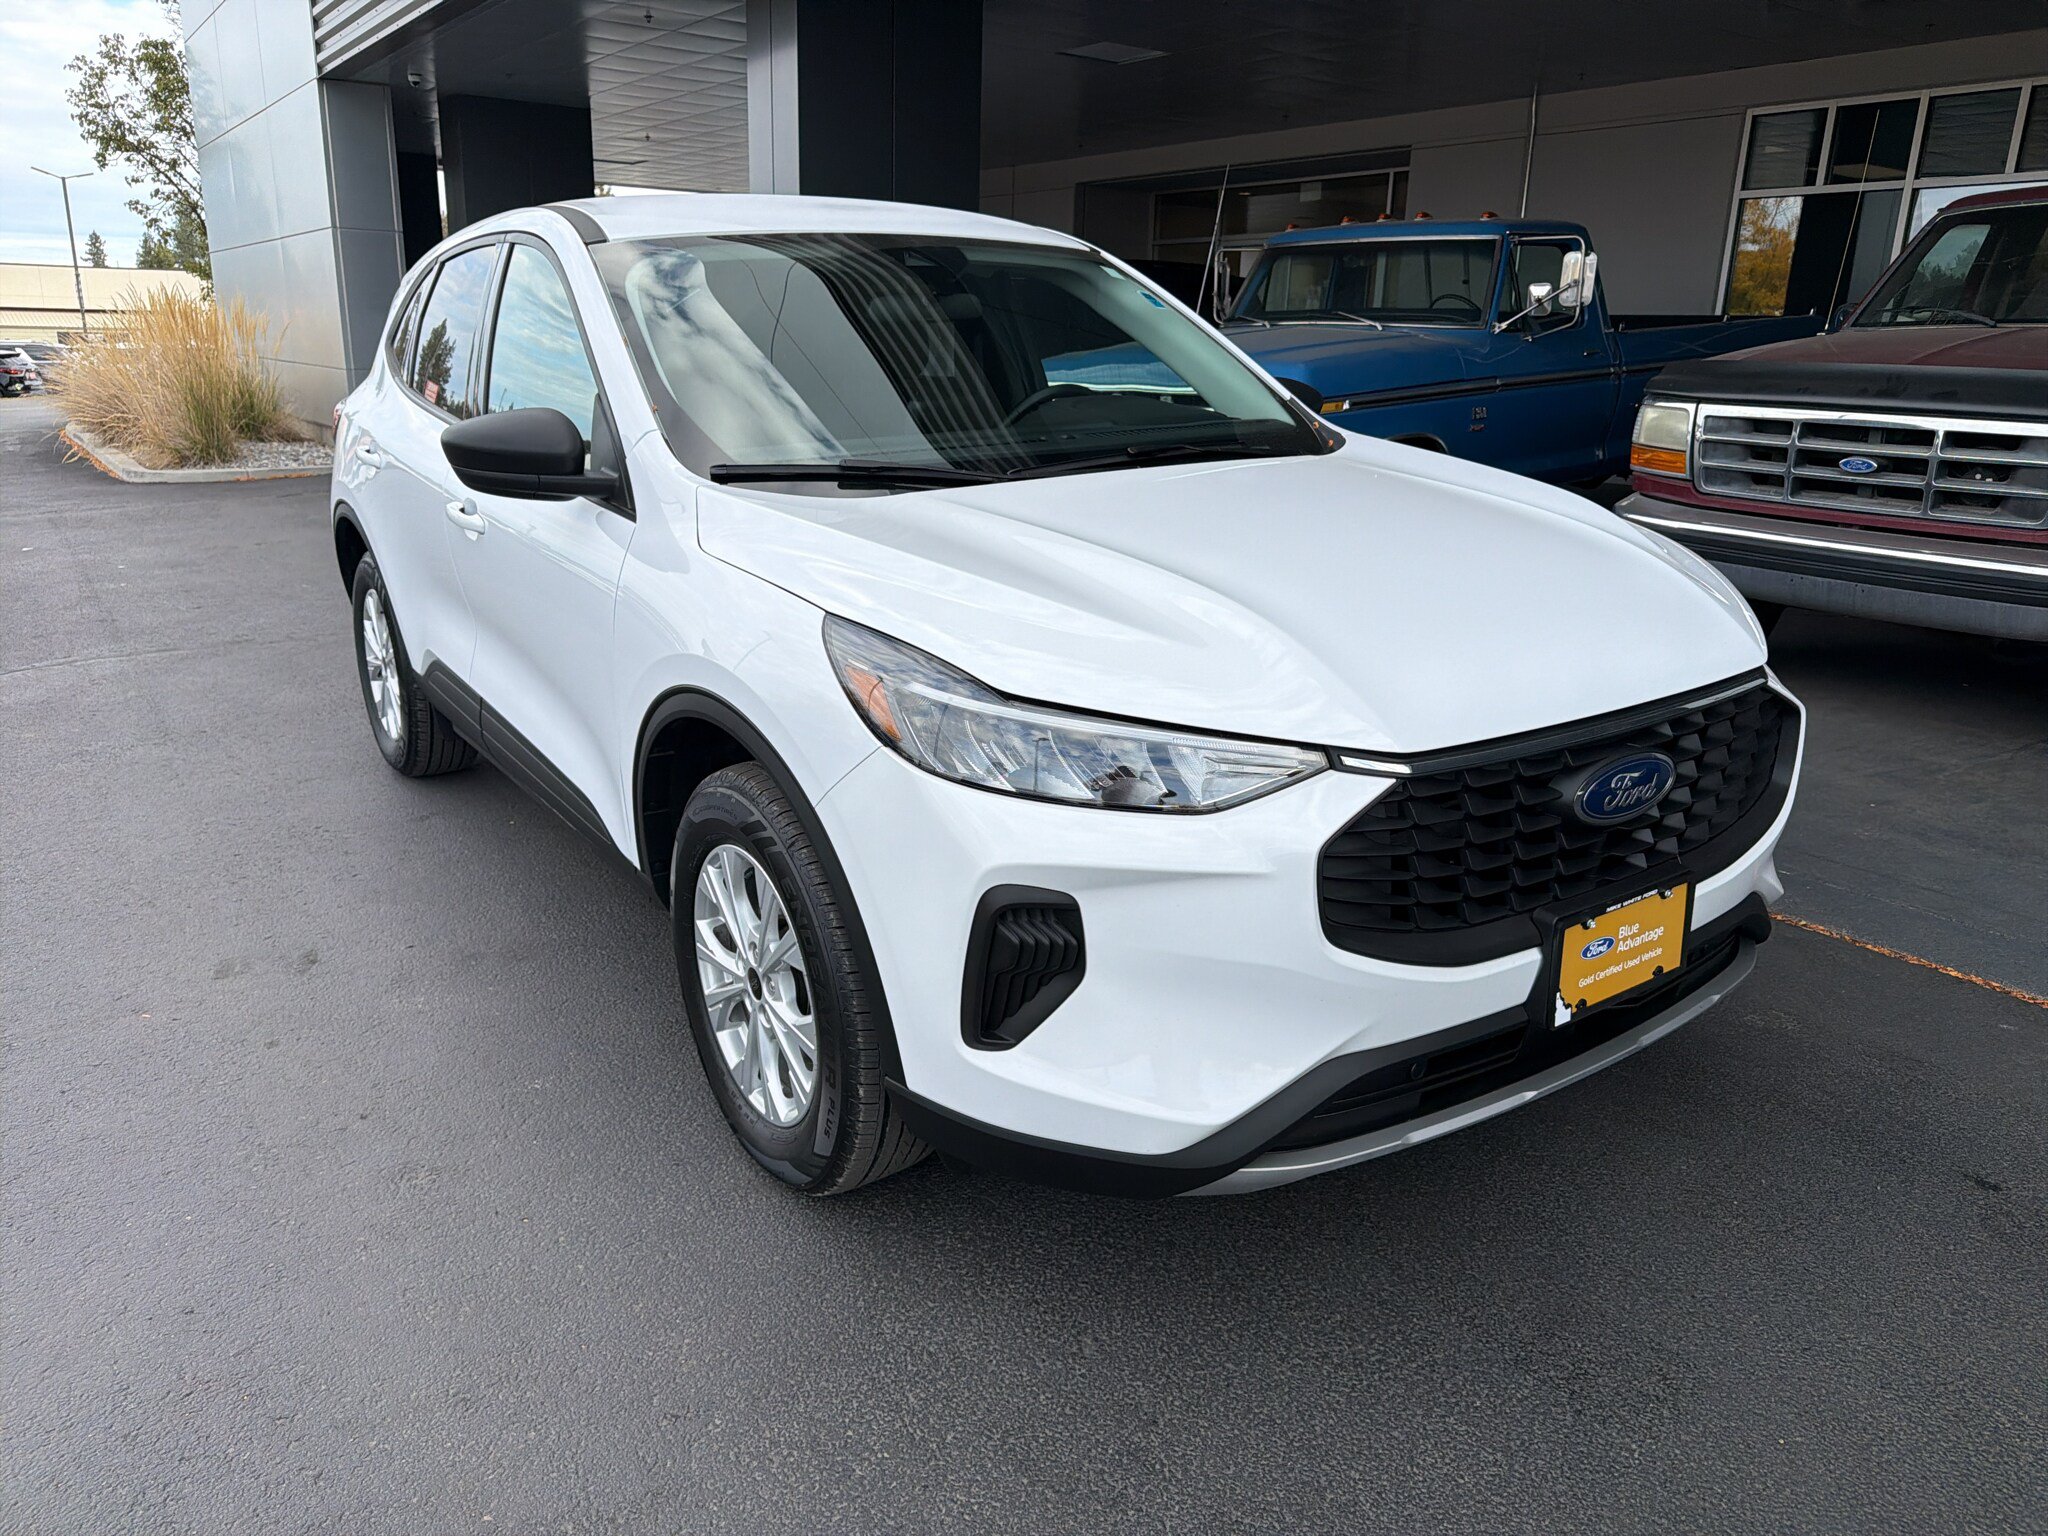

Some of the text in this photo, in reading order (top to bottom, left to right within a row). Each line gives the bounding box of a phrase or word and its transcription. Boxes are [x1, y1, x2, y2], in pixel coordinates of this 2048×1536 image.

[1603, 768, 1660, 811] Ford
[1606, 888, 1659, 912] MIKE WHITE FORD
[1616, 926, 1664, 954] Advantage
[1618, 923, 1640, 939] Blue
[1586, 940, 1609, 957] Ford
[1578, 946, 1663, 988] Gold Certified Used Vehicle
[823, 1096, 836, 1139] PLUS
